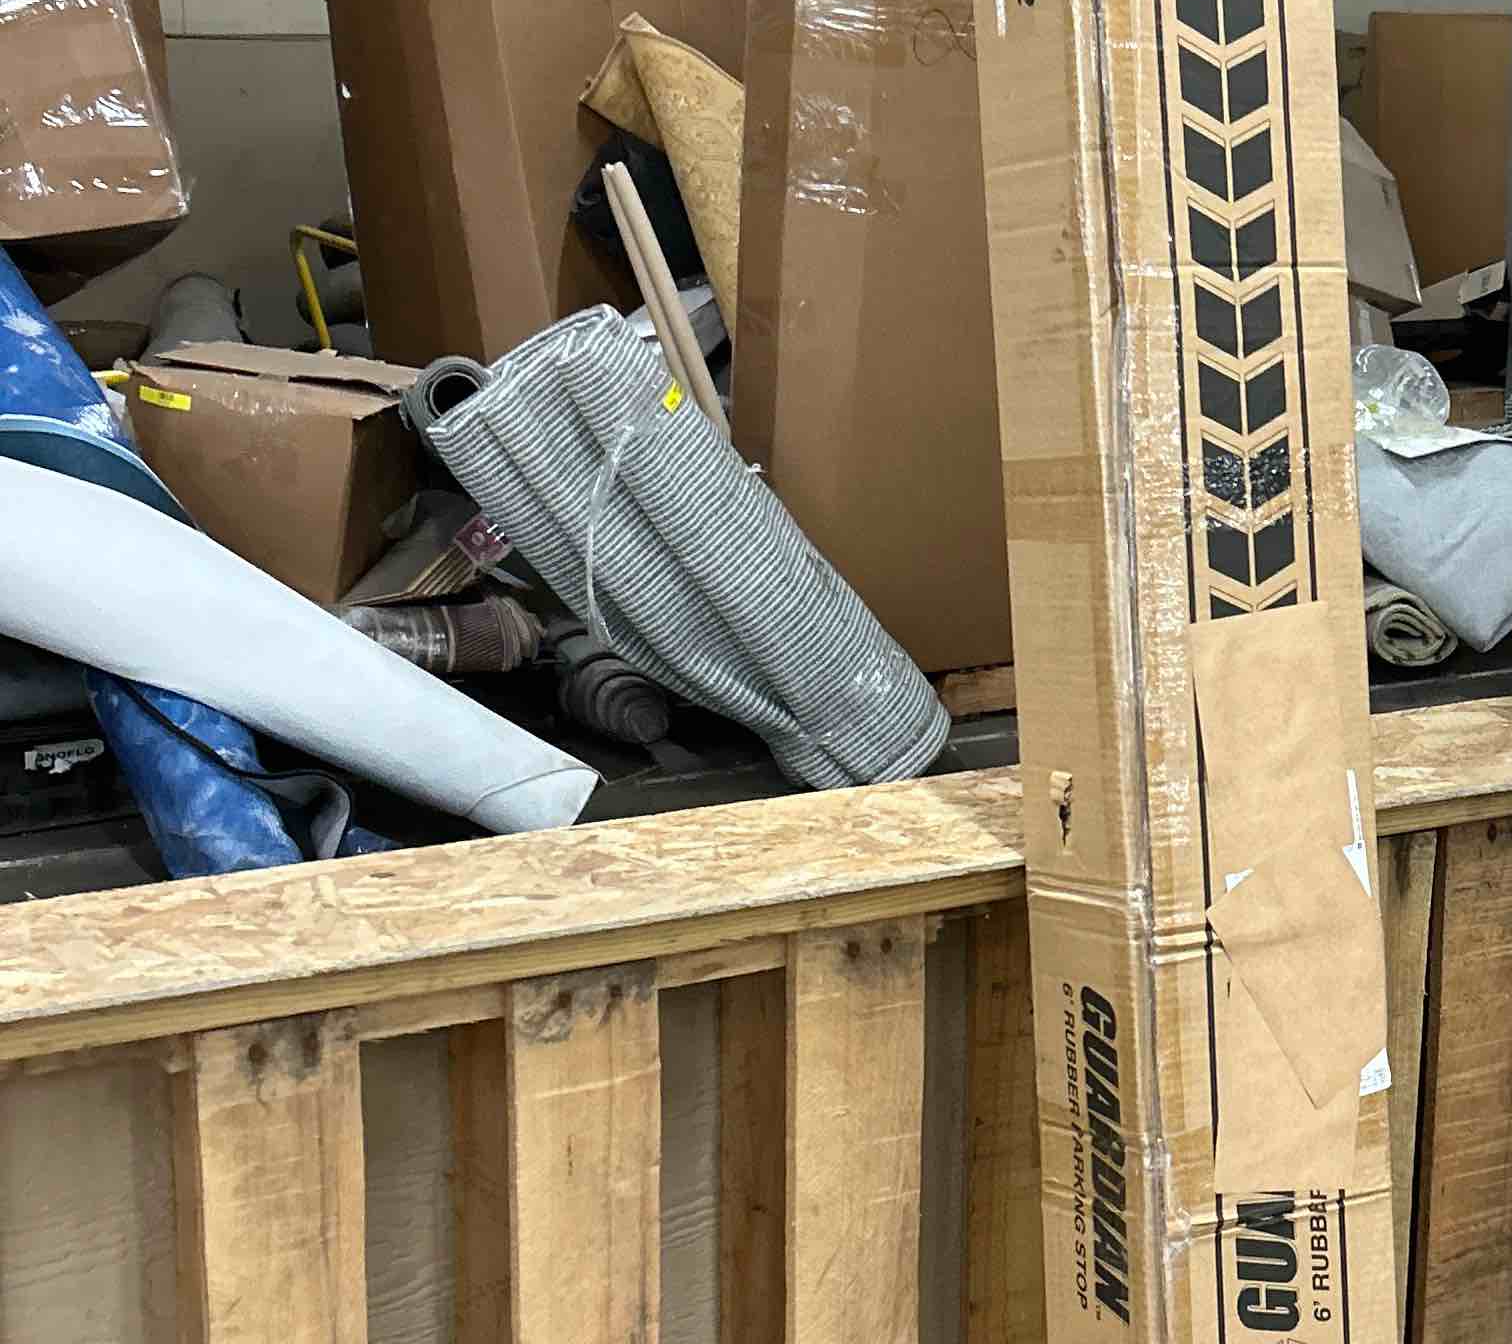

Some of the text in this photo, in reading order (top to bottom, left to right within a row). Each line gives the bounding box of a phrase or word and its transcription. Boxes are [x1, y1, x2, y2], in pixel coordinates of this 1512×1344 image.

[1064, 1010, 1081, 1116] RUBBER
[1070, 1120, 1087, 1234] PARKING
[1075, 1237, 1089, 1311] STOP
[1236, 1190, 1300, 1332] GUA
[1312, 1300, 1332, 1322] 6'
